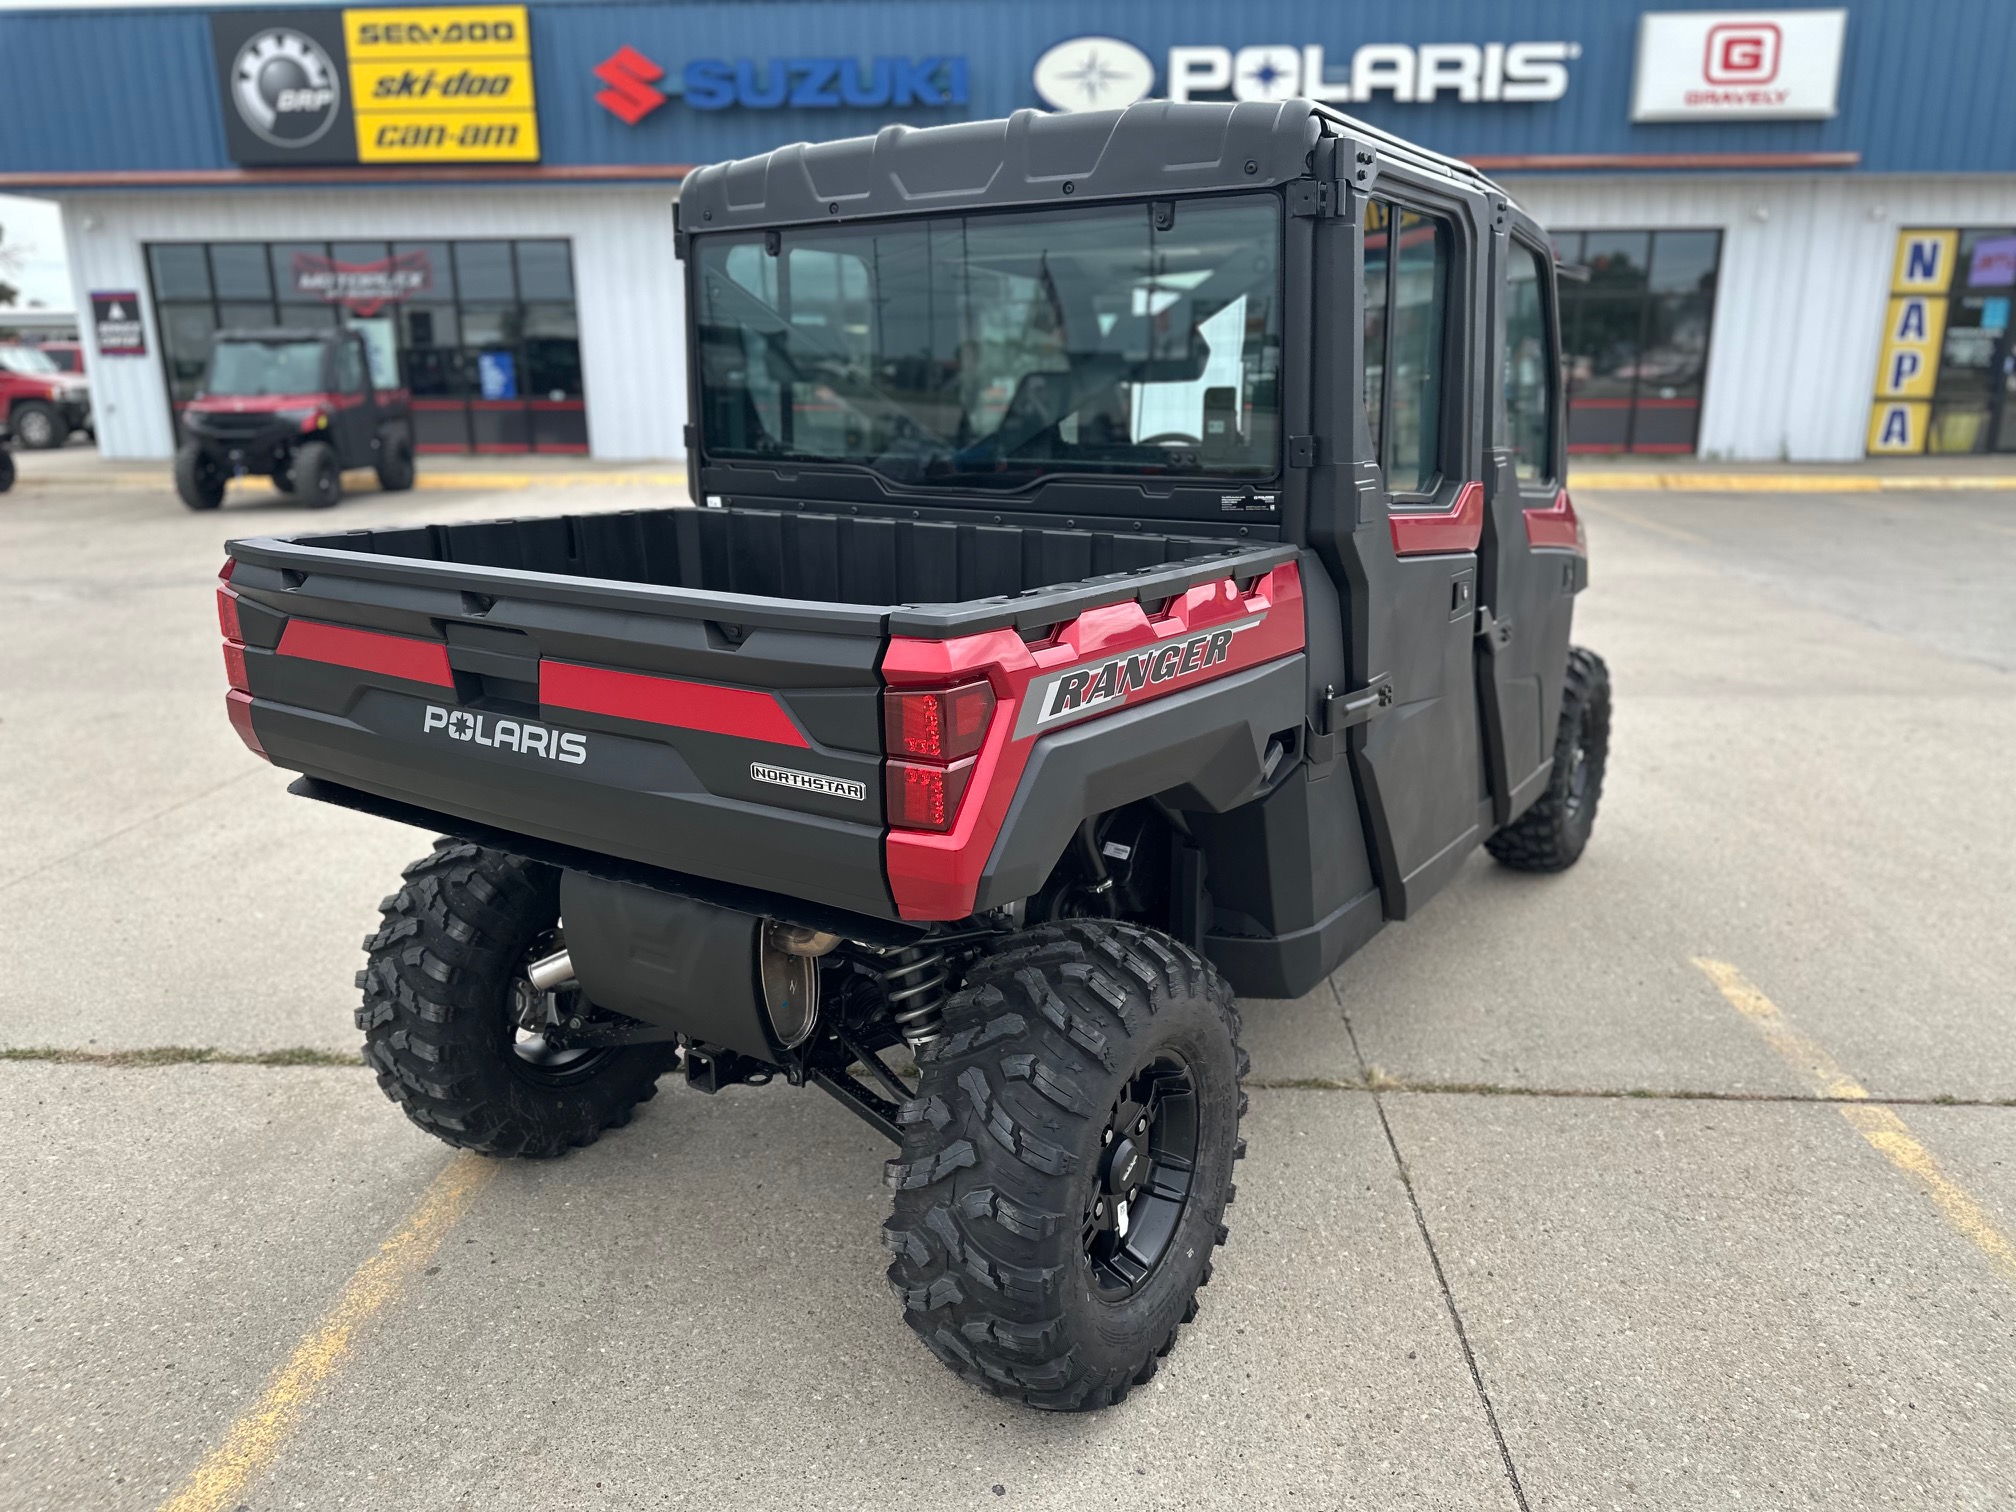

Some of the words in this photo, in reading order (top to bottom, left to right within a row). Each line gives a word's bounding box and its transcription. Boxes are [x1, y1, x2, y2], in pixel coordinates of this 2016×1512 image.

[372, 70, 512, 98] ski-doo
[684, 56, 969, 109] SUZUKI
[1168, 42, 1569, 101] POLARIS
[1684, 90, 1788, 106] GRAVELY
[375, 123, 519, 148] can-am
[1048, 628, 1234, 717] RANGER
[423, 705, 587, 765] POLARIS
[755, 767, 860, 796] NORTHSTAR
